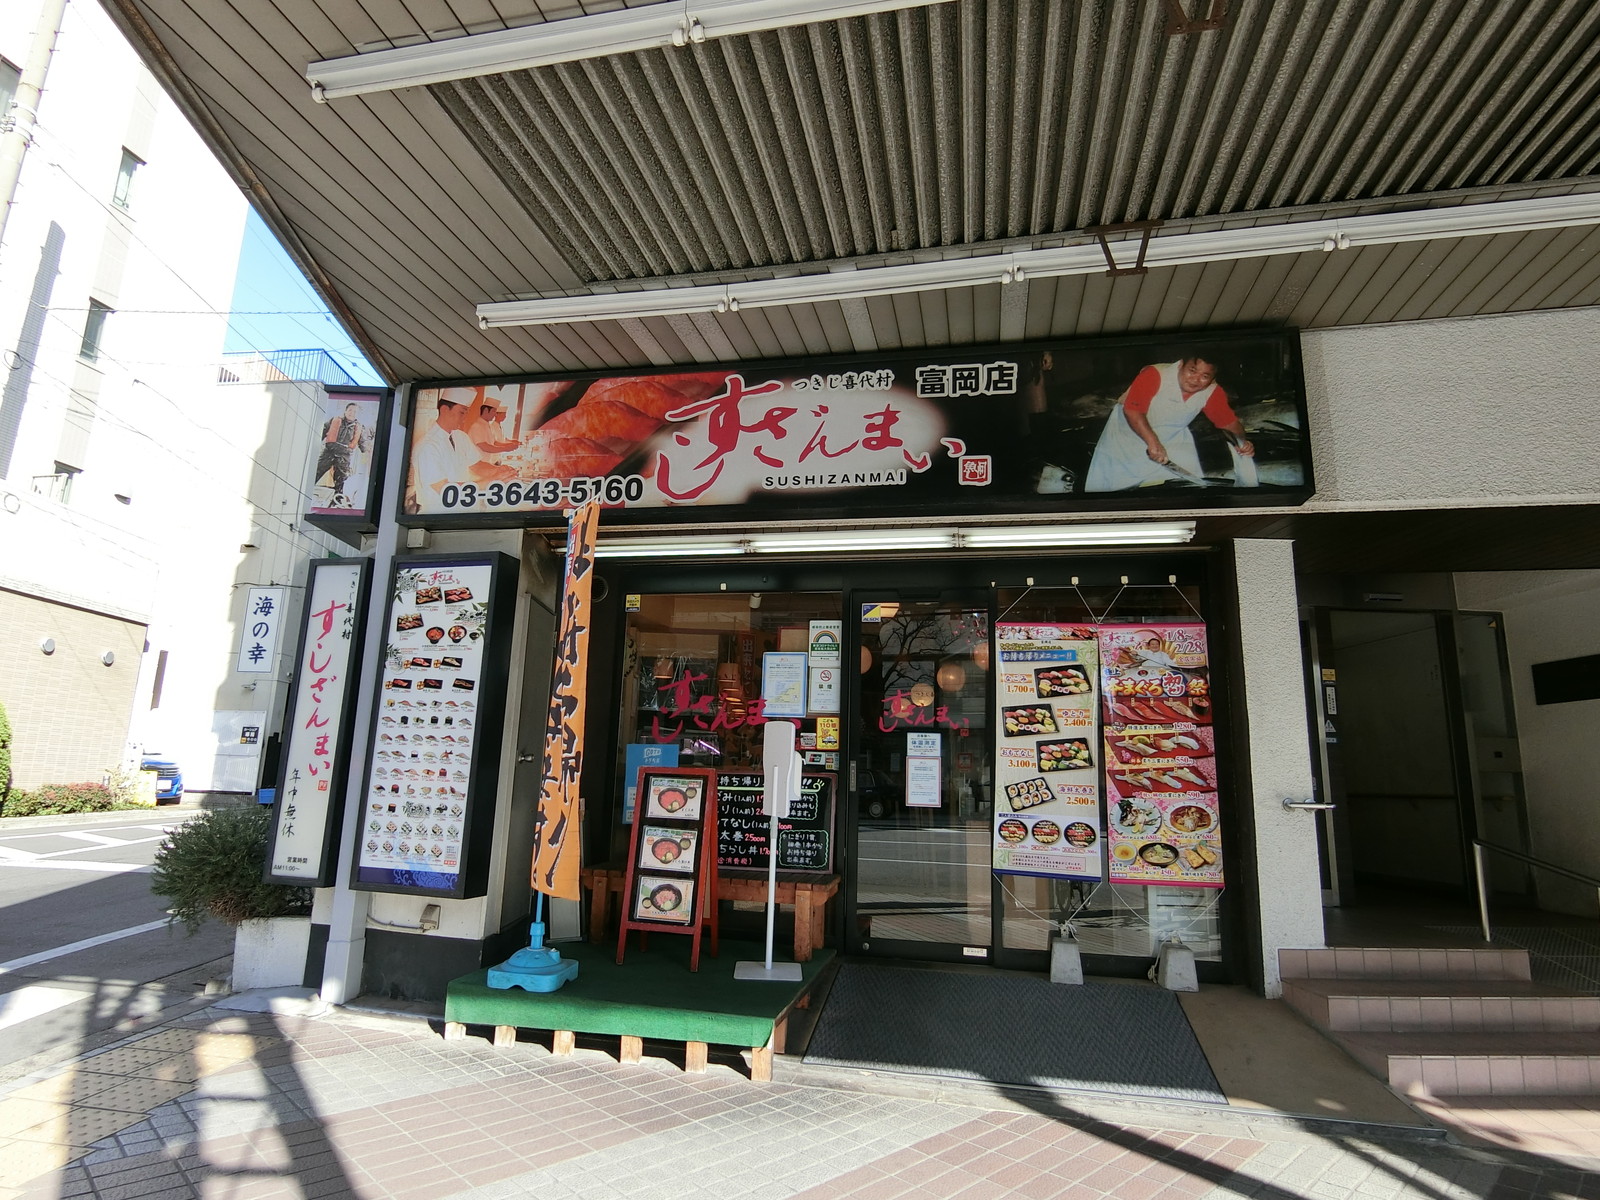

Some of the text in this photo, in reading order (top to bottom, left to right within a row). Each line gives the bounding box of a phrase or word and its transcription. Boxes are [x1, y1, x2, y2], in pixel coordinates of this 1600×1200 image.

[793, 372, 893, 391] つきじ喜代村
[917, 363, 1016, 396] 富岡店
[656, 376, 966, 501] すしざんまい
[442, 477, 644, 509] 03-3643-5160
[764, 472, 905, 488] SUSHIZANMAI
[248, 596, 275, 665] 海の幸
[306, 600, 347, 776] すしざんまい
[1062, 710, 1085, 718] ゆとり
[1001, 748, 1032, 757] おもてなし
[282, 768, 301, 838] 年中無休
[287, 856, 308, 864] 営業時間
